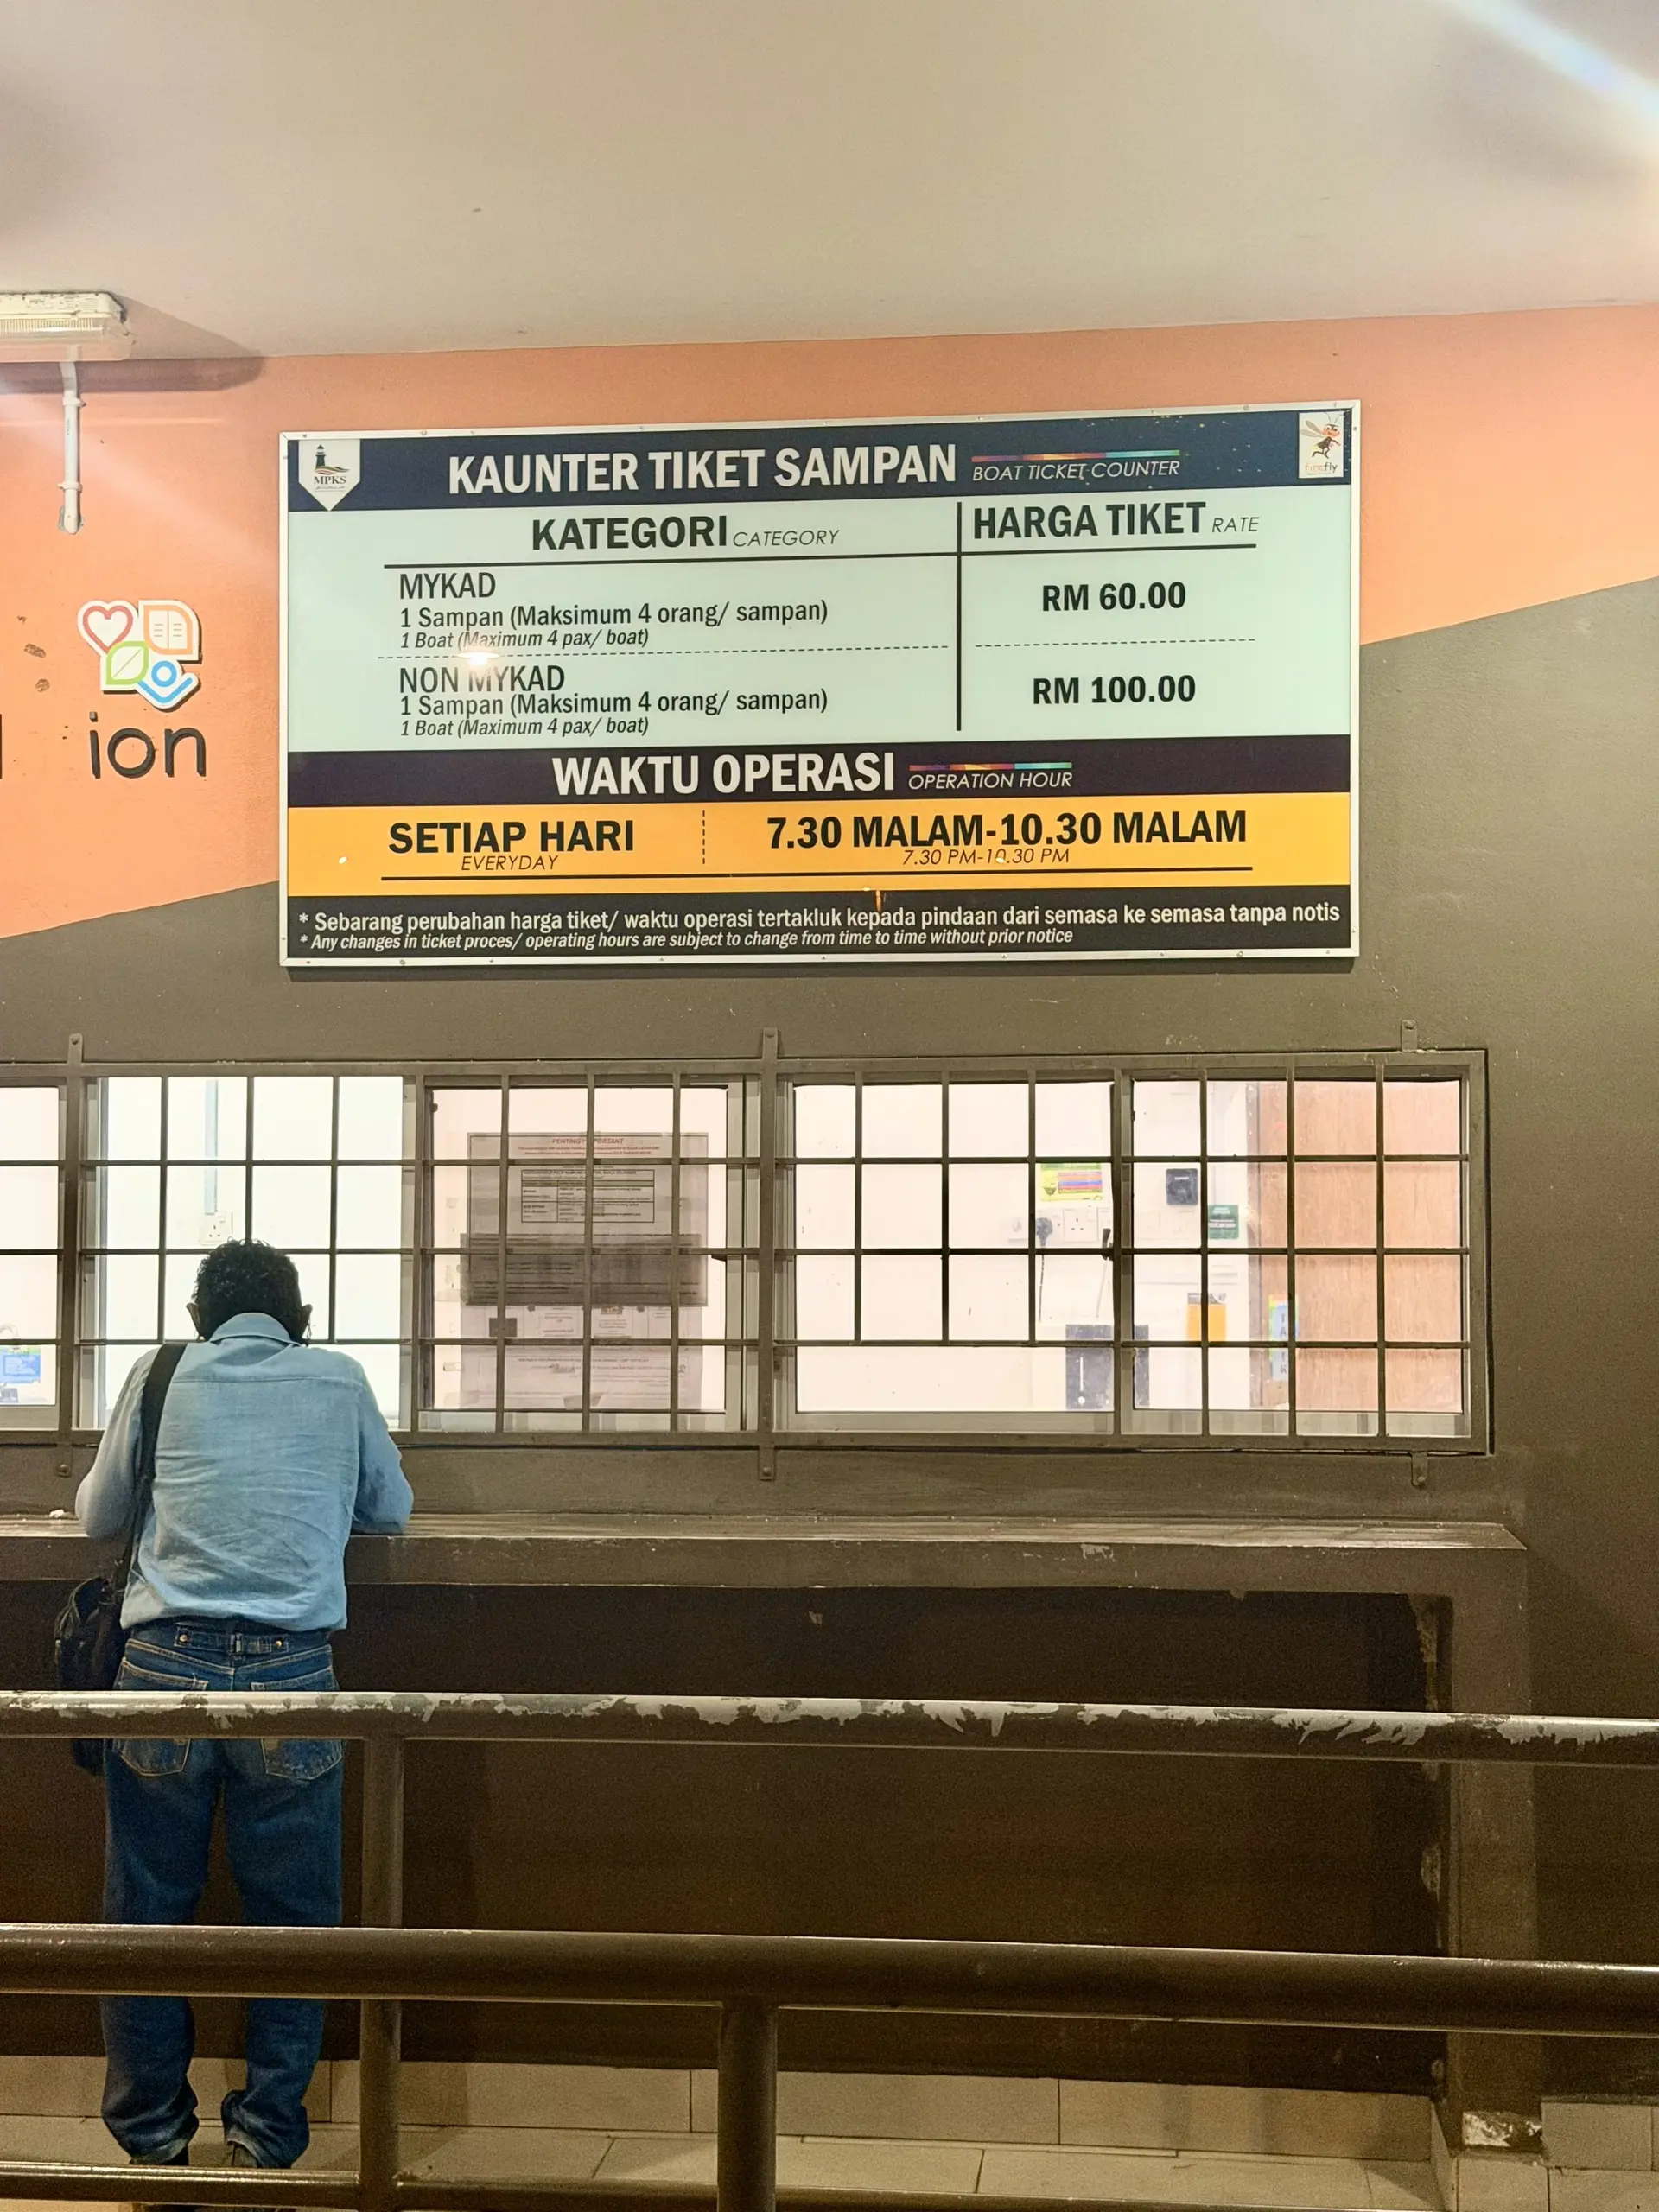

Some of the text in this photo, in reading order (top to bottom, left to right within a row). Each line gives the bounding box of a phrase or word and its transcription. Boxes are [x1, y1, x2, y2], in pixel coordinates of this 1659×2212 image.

[450, 444, 955, 493] KAUNTER TIKET SAMPAN
[973, 461, 1179, 480] BOAT TICKET COUNTER
[1306, 461, 1338, 474] firefly
[533, 516, 839, 550] KATEGORI CATEGORY
[975, 502, 1259, 539] HARGA TIKET RATE
[401, 572, 495, 599] MYKAD
[1043, 582, 1185, 611] RM 60.00
[402, 600, 827, 631] 1 Sampan (Maksimum 4 orang/ sampan)
[401, 628, 648, 649] 1 Boat (Maximum 4 pax/ boat)
[400, 665, 565, 693] NON MYKAD
[1033, 675, 1195, 704] RM 100.00
[402, 689, 827, 719] 1 Sampan (Maksimum 4 orang/ sampan)
[401, 717, 648, 739] 1 Boat (Maximum 4 pax/ boat)
[552, 753, 893, 795] WAKTU OPERASI
[909, 772, 1072, 789] OPERATION HOUR
[389, 820, 632, 854] SETIAP HARI
[767, 810, 1245, 849] 7.30 MALAM-10.30 MALAM
[461, 855, 558, 870] EVERYDAY
[903, 849, 941, 865] 7.30
[1040, 849, 1069, 862] PM
[315, 912, 403, 934] Sebarang
[406, 911, 507, 934] perubahan
[511, 912, 562, 933] harga
[567, 911, 619, 932] tiket/
[625, 911, 678, 928] waktu
[684, 909, 752, 934] operasi
[758, 908, 842, 927] tertakluk
[847, 906, 918, 929] kepada
[922, 906, 997, 929] pindaan
[1003, 906, 1039, 925] dari
[1045, 909, 1117, 924] semasa
[1124, 905, 1145, 923] ke
[1151, 908, 1224, 923] semasa
[1230, 905, 1286, 925] tanpa
[1293, 902, 1339, 921] notis
[311, 935, 338, 951] Any
[340, 934, 400, 951] changes
[404, 933, 417, 948] in
[422, 934, 461, 948] ticket
[464, 932, 523, 950] proces/
[525, 931, 594, 951] operating
[599, 932, 639, 946] hours
[643, 936, 665, 946] are
[670, 931, 722, 950] subject
[727, 932, 741, 945] to
[745, 931, 798, 949] change
[802, 931, 835, 944] from
[840, 930, 872, 944] time
[876, 931, 890, 944] to
[894, 930, 926, 944] time
[931, 929, 986, 944] without
[988, 929, 1024, 946] prior
[1027, 928, 1072, 943] notice
